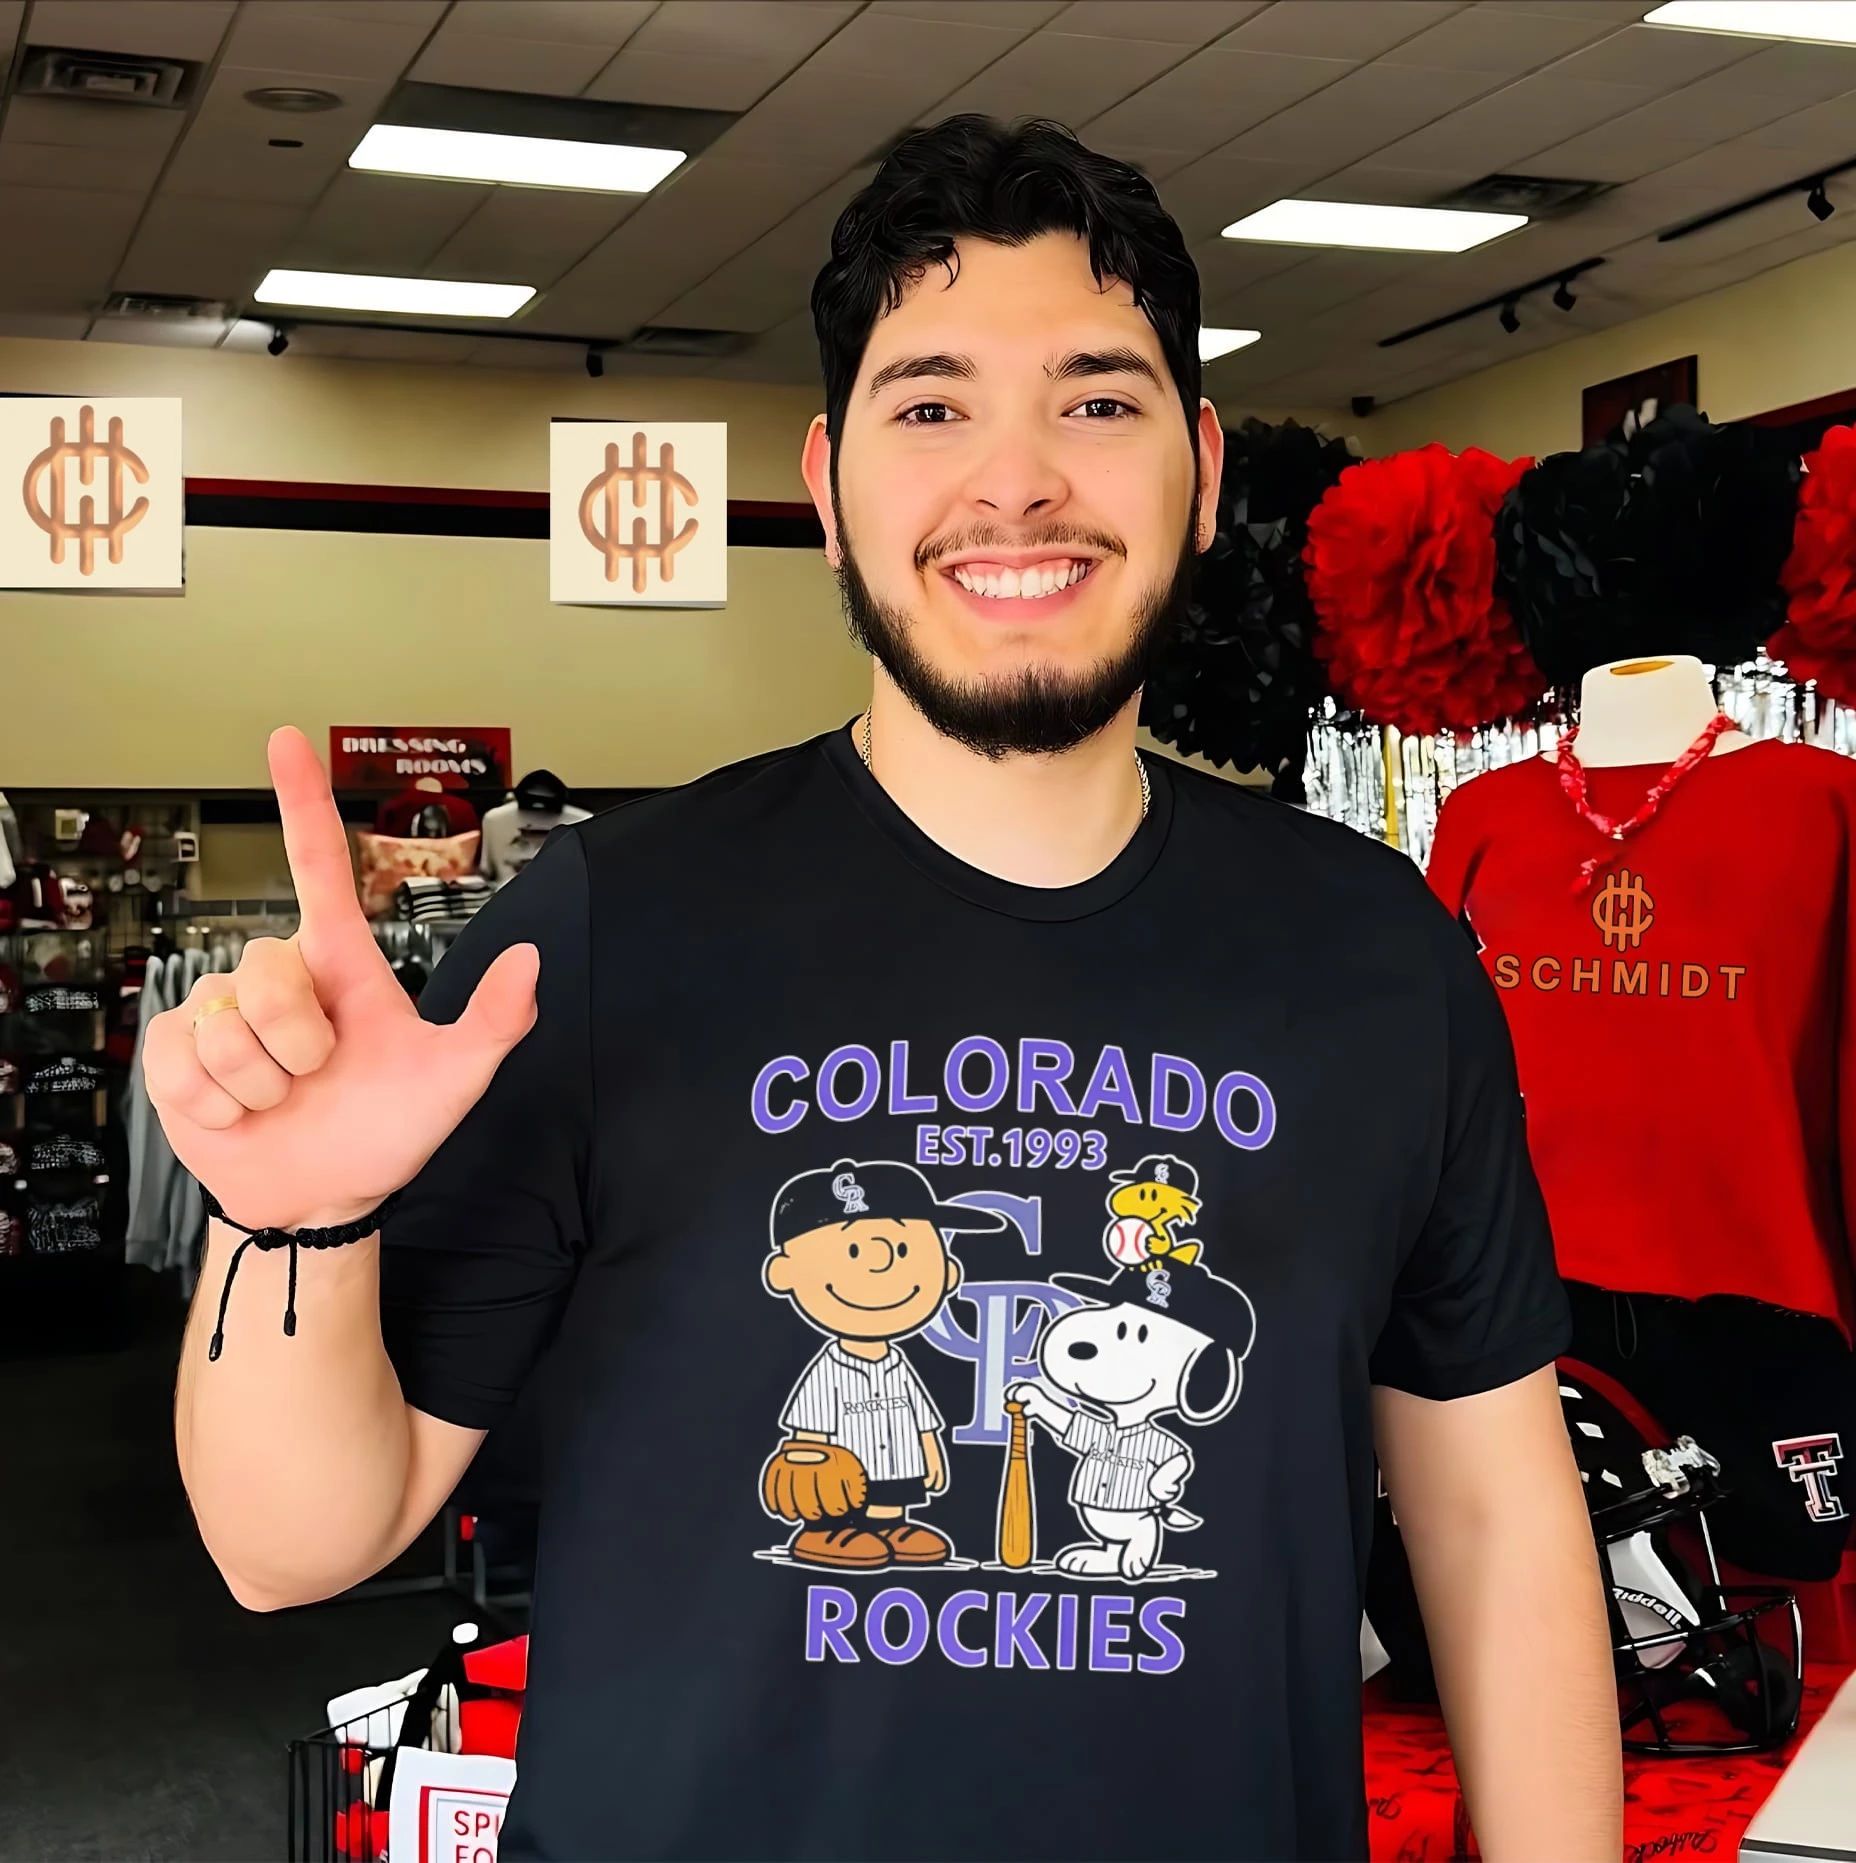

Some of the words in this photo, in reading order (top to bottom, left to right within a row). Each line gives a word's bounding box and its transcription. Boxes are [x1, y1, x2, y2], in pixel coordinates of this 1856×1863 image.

[1494, 953, 1747, 1001] SCHMIDT
[751, 1035, 1277, 1151] COLORADO
[915, 1124, 1108, 1171] EST.1993
[805, 1585, 1187, 1675] ROCKIES
